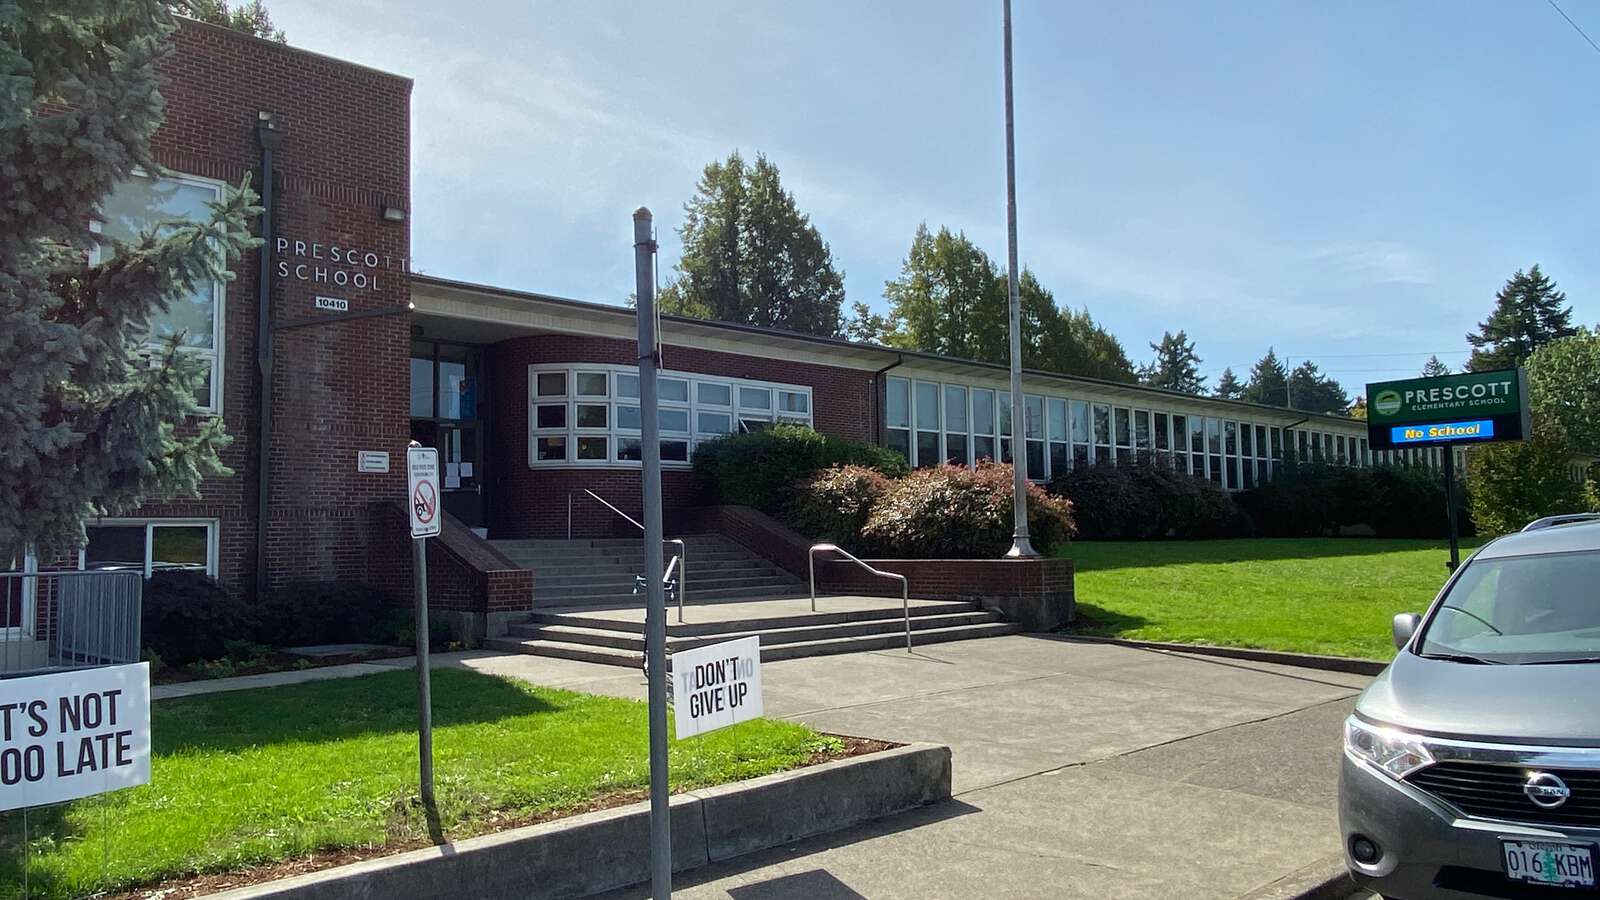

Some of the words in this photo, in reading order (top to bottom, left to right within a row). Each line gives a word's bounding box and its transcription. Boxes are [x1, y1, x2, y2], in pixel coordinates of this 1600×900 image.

[277, 237, 409, 273] PRESCOTT
[278, 261, 382, 292] SCHOOL
[317, 298, 347, 310] 10410
[1405, 381, 1512, 404] PRESCOTT
[1412, 401, 1466, 411] ELEMENTARY
[1469, 398, 1506, 407] SCHOOL
[1405, 428, 1424, 439] No
[1429, 423, 1481, 438] School
[695, 656, 739, 690] DON'T
[0, 700, 48, 742] T'S
[59, 689, 122, 733] NOT
[690, 687, 724, 719] GIVE
[728, 682, 748, 709] UP
[0, 745, 45, 785] OO
[57, 730, 133, 777] LATE
[1508, 850, 1543, 873] 016
[1555, 853, 1592, 879] KBM
